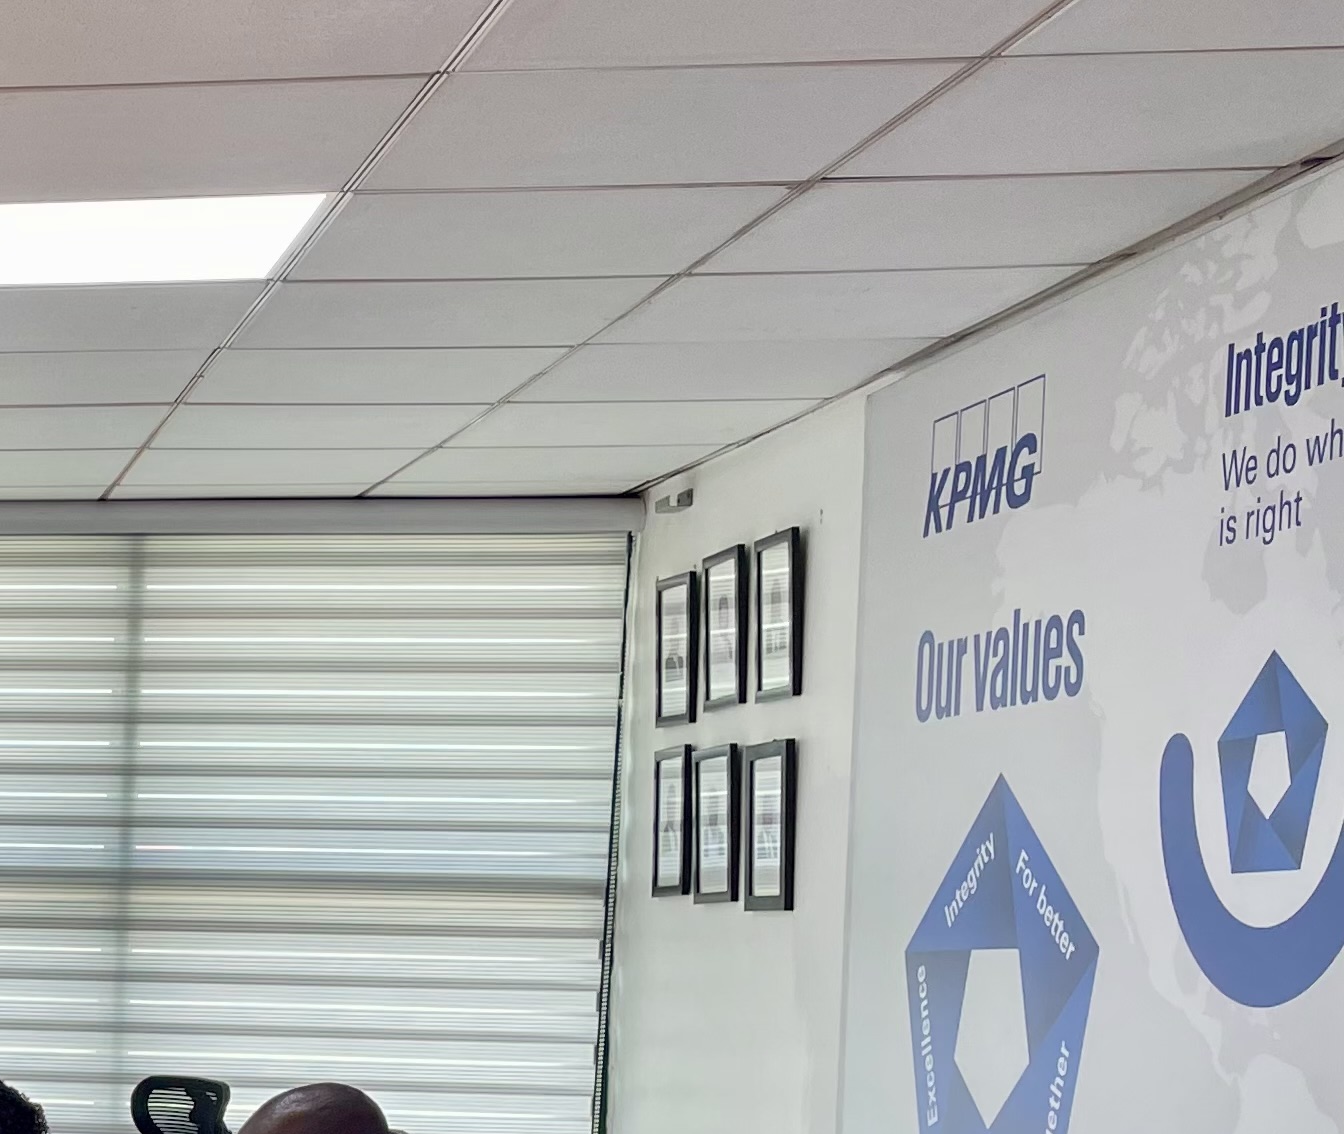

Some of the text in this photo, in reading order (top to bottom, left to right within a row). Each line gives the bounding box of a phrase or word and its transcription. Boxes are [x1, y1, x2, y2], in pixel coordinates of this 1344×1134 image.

[1225, 301, 1344, 418] Integrit
[923, 432, 1038, 539] KPMG
[1222, 445, 1258, 491] We
[1266, 435, 1297, 478] do
[1219, 490, 1303, 546] is right
[915, 608, 1086, 723] Our values
[944, 832, 995, 928] Integrity
[1015, 849, 1076, 960] For better
[917, 964, 939, 1127] Excellence
